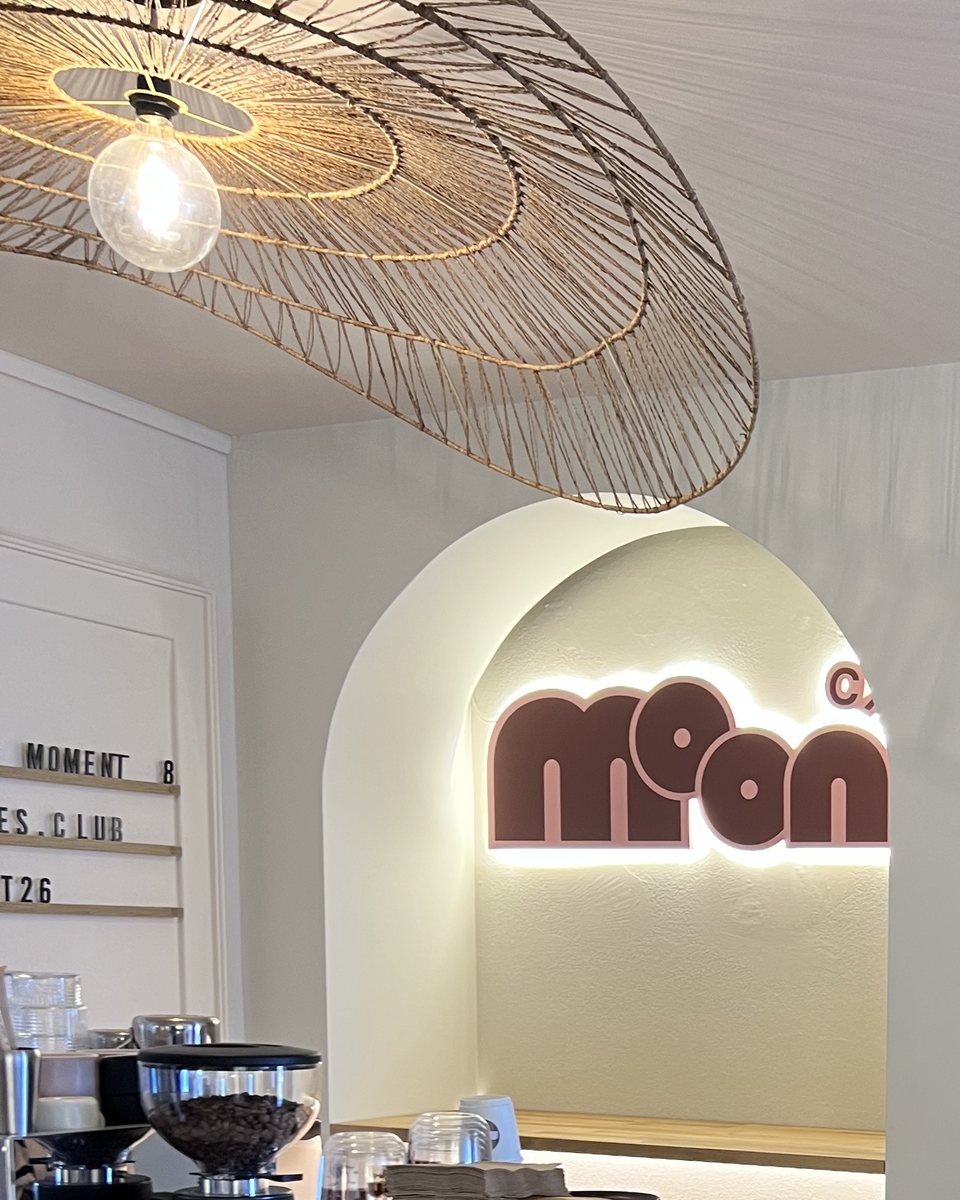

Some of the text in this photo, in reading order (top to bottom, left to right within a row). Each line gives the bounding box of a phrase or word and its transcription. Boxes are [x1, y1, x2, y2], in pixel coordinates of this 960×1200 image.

[27, 742, 174, 785] MOMENT 8
[488, 677, 890, 851] moon
[0, 875, 52, 904] T26
